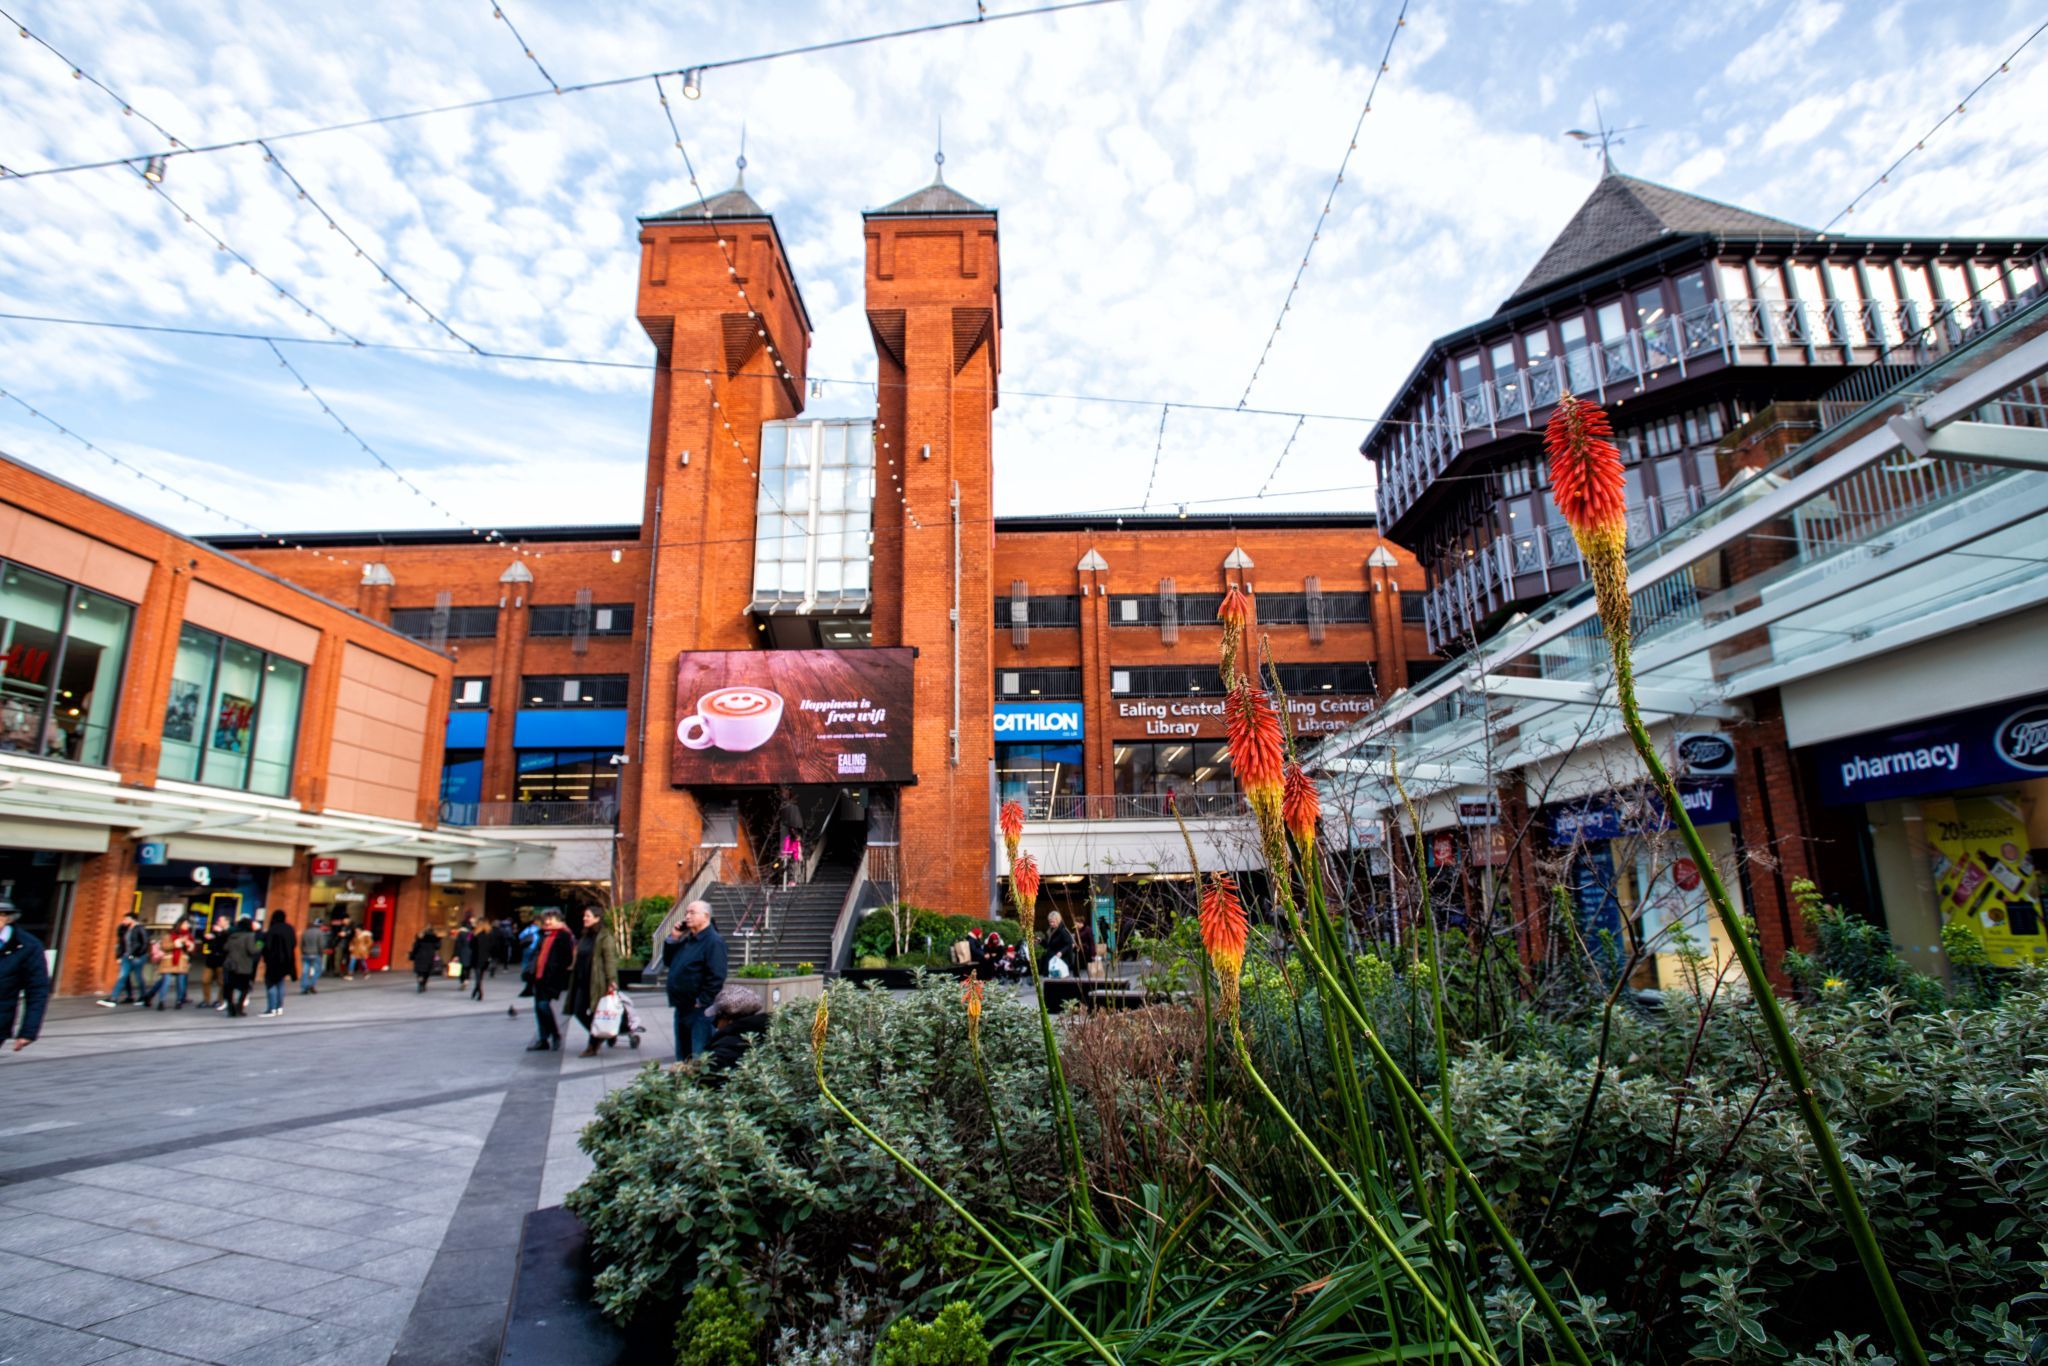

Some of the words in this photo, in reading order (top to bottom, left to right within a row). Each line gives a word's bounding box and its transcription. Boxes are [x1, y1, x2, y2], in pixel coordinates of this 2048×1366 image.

[800, 699, 858, 712] Happiness
[860, 698, 871, 709] is
[1119, 702, 1166, 718] Ealing
[1170, 701, 1226, 716] Central
[1270, 699, 1316, 716] Eling
[1320, 699, 1374, 714] Central
[825, 711, 855, 726] free
[857, 709, 886, 725] wifi
[1146, 720, 1200, 736] Library
[838, 753, 867, 767] EALING
[1841, 743, 1960, 787] pharmacy
[1682, 787, 1713, 811] auty
